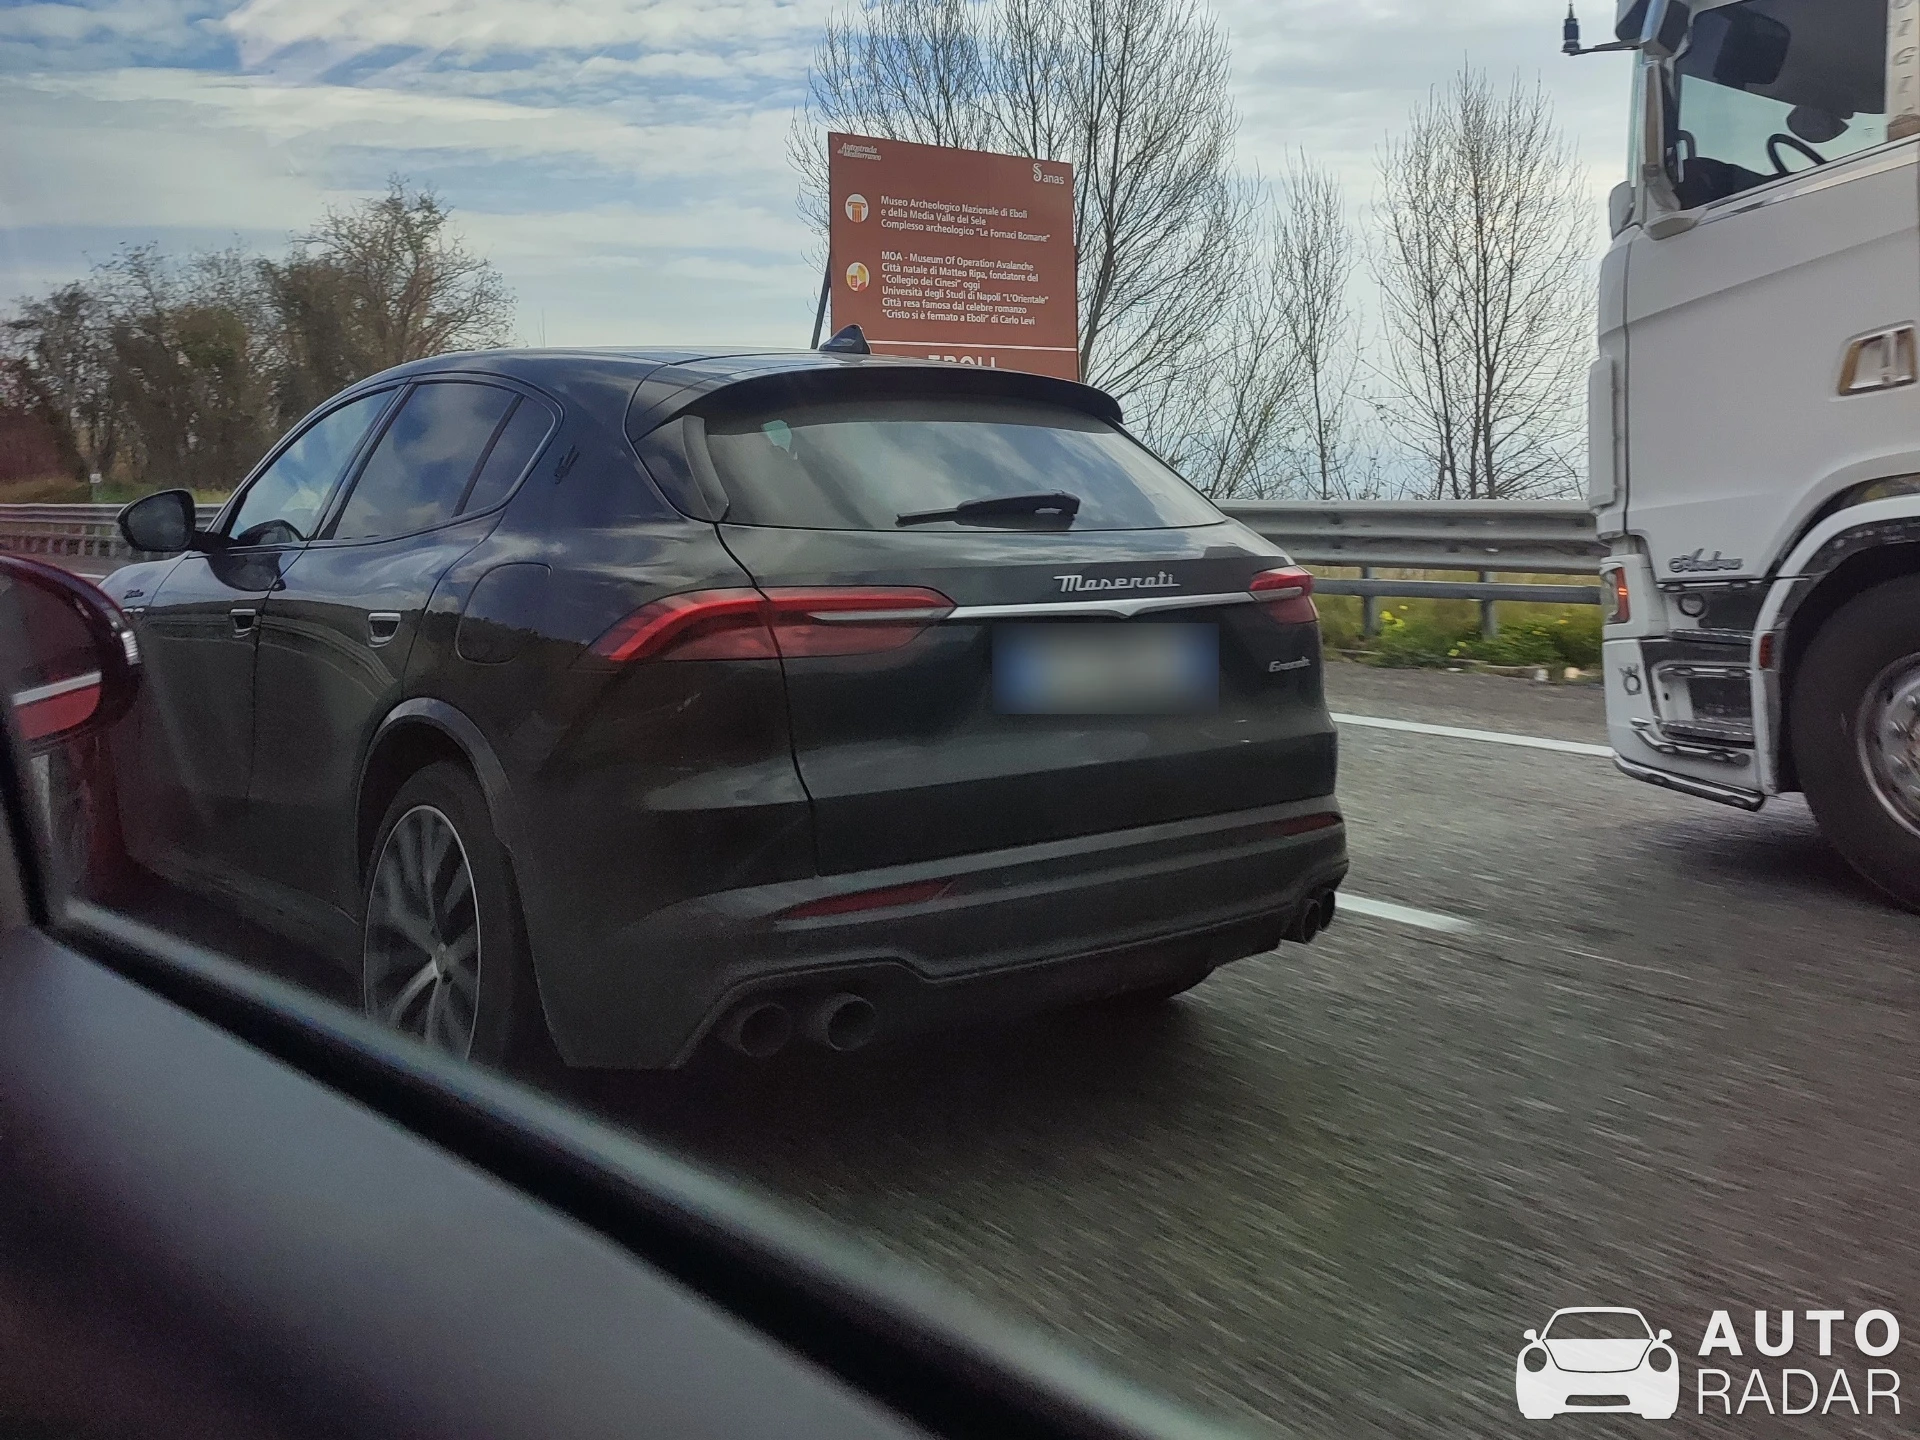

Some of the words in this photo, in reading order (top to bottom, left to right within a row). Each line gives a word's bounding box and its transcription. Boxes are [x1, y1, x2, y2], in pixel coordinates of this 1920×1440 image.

[842, 142, 877, 154] Autostrada
[1043, 174, 1064, 184] anas
[881, 196, 908, 206] Museo
[910, 199, 960, 212] Archeologico
[962, 204, 999, 216] Nazionale
[1000, 208, 1008, 216] di
[1010, 208, 1028, 218] Eboli
[888, 207, 908, 218] della
[910, 210, 934, 220] Media
[936, 212, 955, 222] Valle
[957, 215, 968, 224] del
[970, 216, 986, 226] Sele
[881, 218, 924, 231] Complesso
[926, 223, 974, 236] archeologico
[990, 228, 1016, 239] Fornaci
[882, 251, 902, 260] MOA
[910, 253, 944, 264] Museum
[945, 256, 956, 264] Of
[957, 257, 994, 268] Operation
[996, 260, 1034, 271] Avalanche
[882, 262, 901, 272] Città
[903, 265, 928, 274] natale
[930, 266, 938, 274] di
[939, 267, 967, 276] Matteo
[968, 269, 988, 280] Ripa,
[989, 270, 1026, 281] fondatore
[1027, 274, 1038, 282] del
[920, 276, 932, 286] dei
[963, 280, 980, 290] oggi
[882, 286, 922, 296] Università
[924, 288, 944, 300] degli
[946, 290, 966, 300] Studi
[968, 291, 975, 300] di
[976, 292, 1001, 302] Napoli
[882, 298, 902, 306] Città
[922, 299, 950, 310] famosa
[952, 301, 964, 310] dal
[966, 302, 993, 312] celebre
[994, 305, 1027, 314] romanzo
[912, 310, 918, 319] si
[920, 310, 926, 320] è
[927, 311, 958, 322] fermato
[991, 314, 998, 324] di
[1000, 315, 1019, 324] Carlo
[1020, 316, 1036, 325] Levi
[1053, 571, 1181, 592] Maserati
